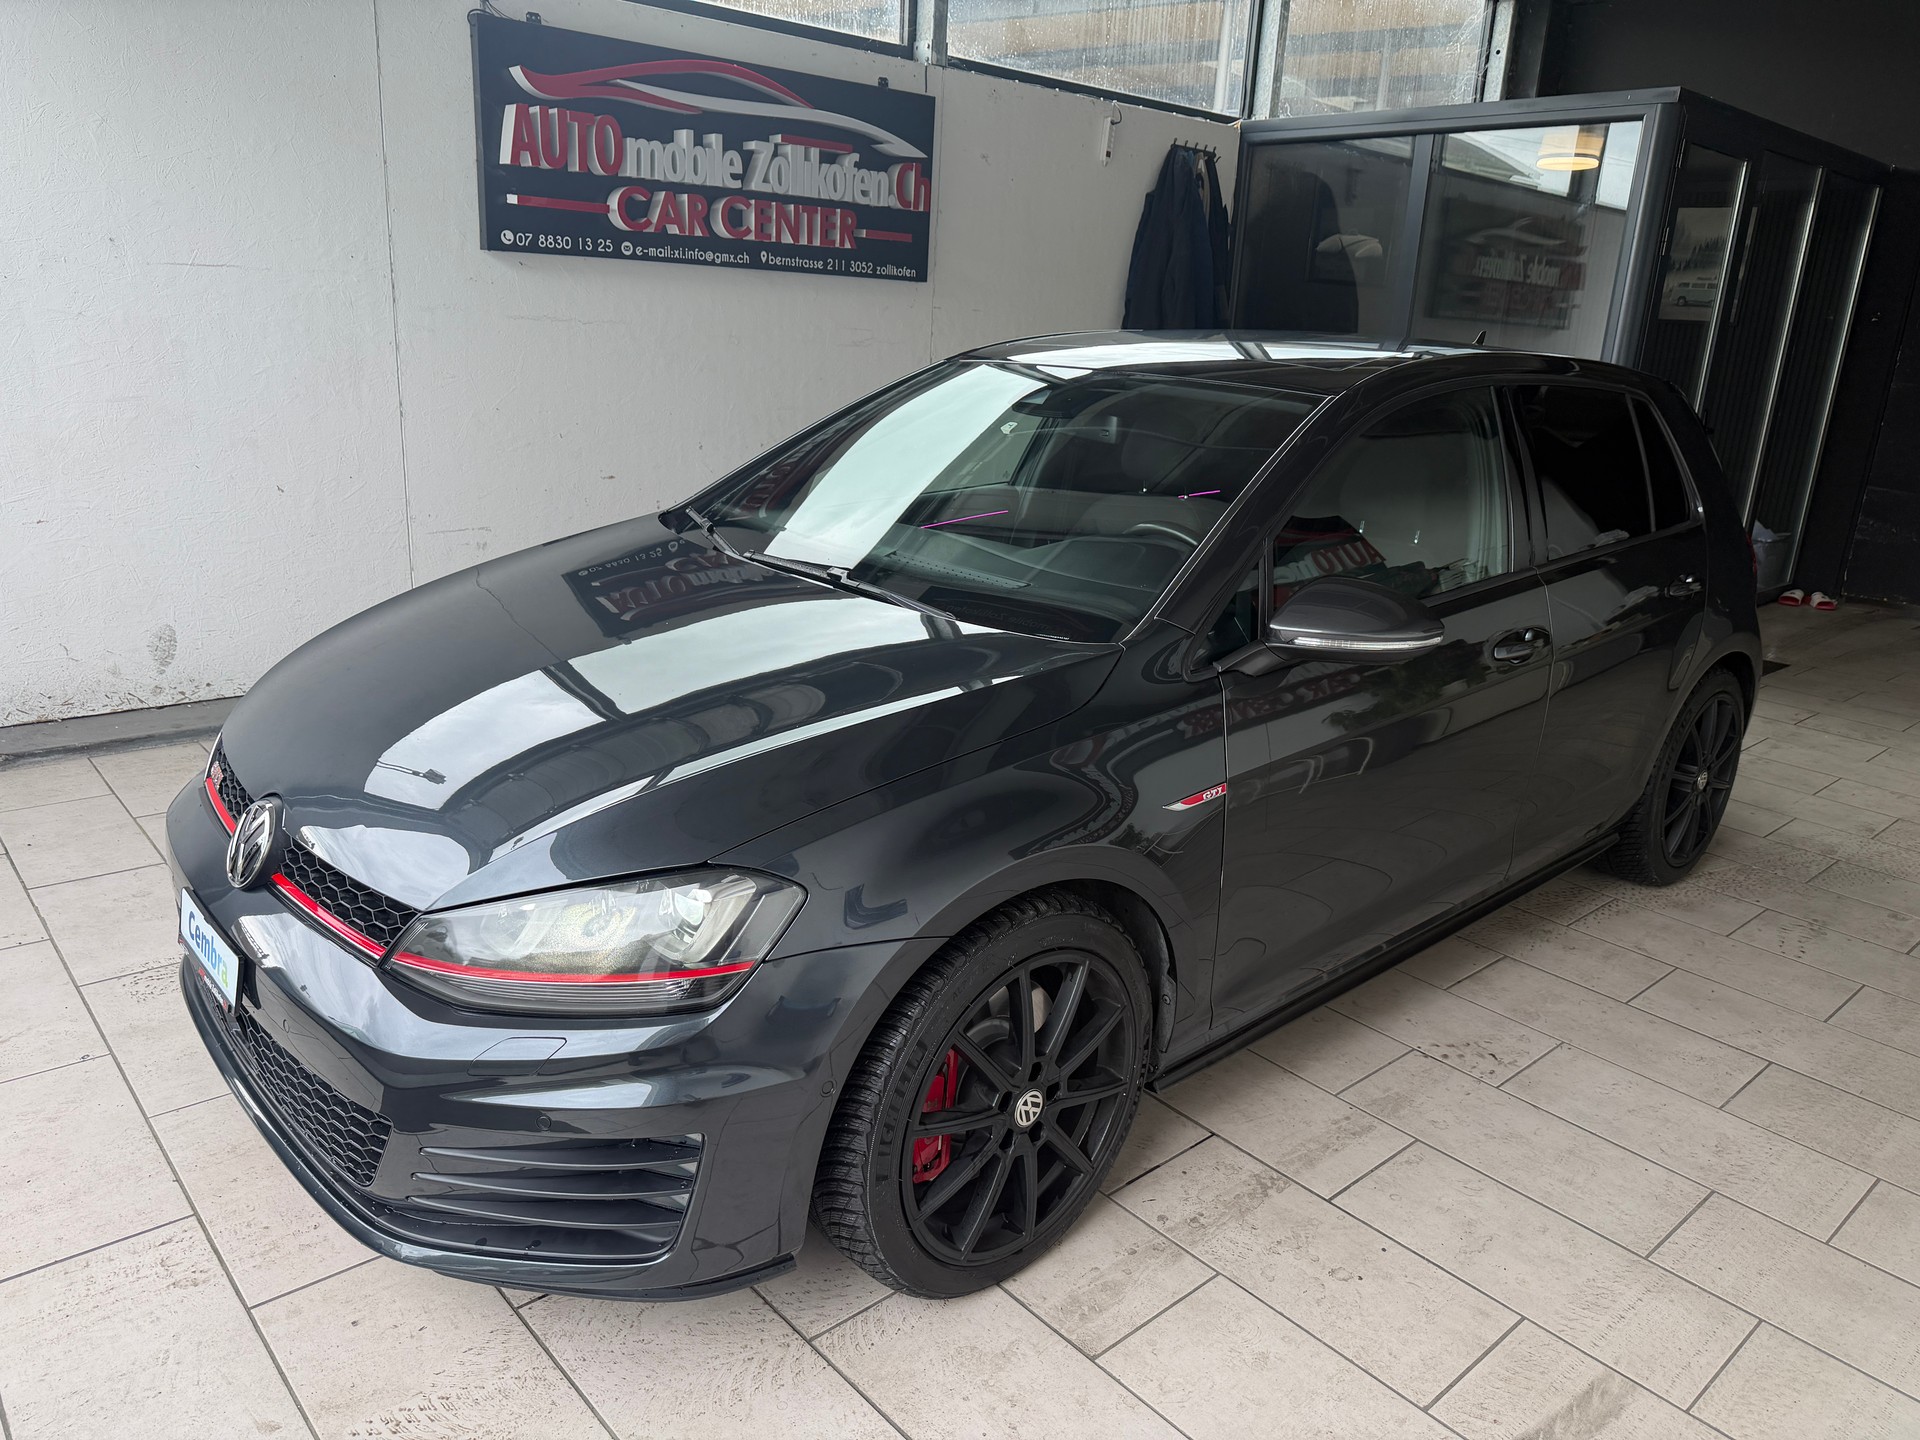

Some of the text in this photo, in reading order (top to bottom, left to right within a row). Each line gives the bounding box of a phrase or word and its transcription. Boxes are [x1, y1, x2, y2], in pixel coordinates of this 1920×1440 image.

[607, 186, 857, 249] CAR CENTER
[516, 232, 614, 252] 07 8830 13 25
[768, 252, 824, 269] bernstrasse
[850, 260, 873, 274] 3052
[876, 264, 917, 278] zollikofen
[1202, 786, 1223, 801] GTI
[188, 910, 229, 989] Cembra
